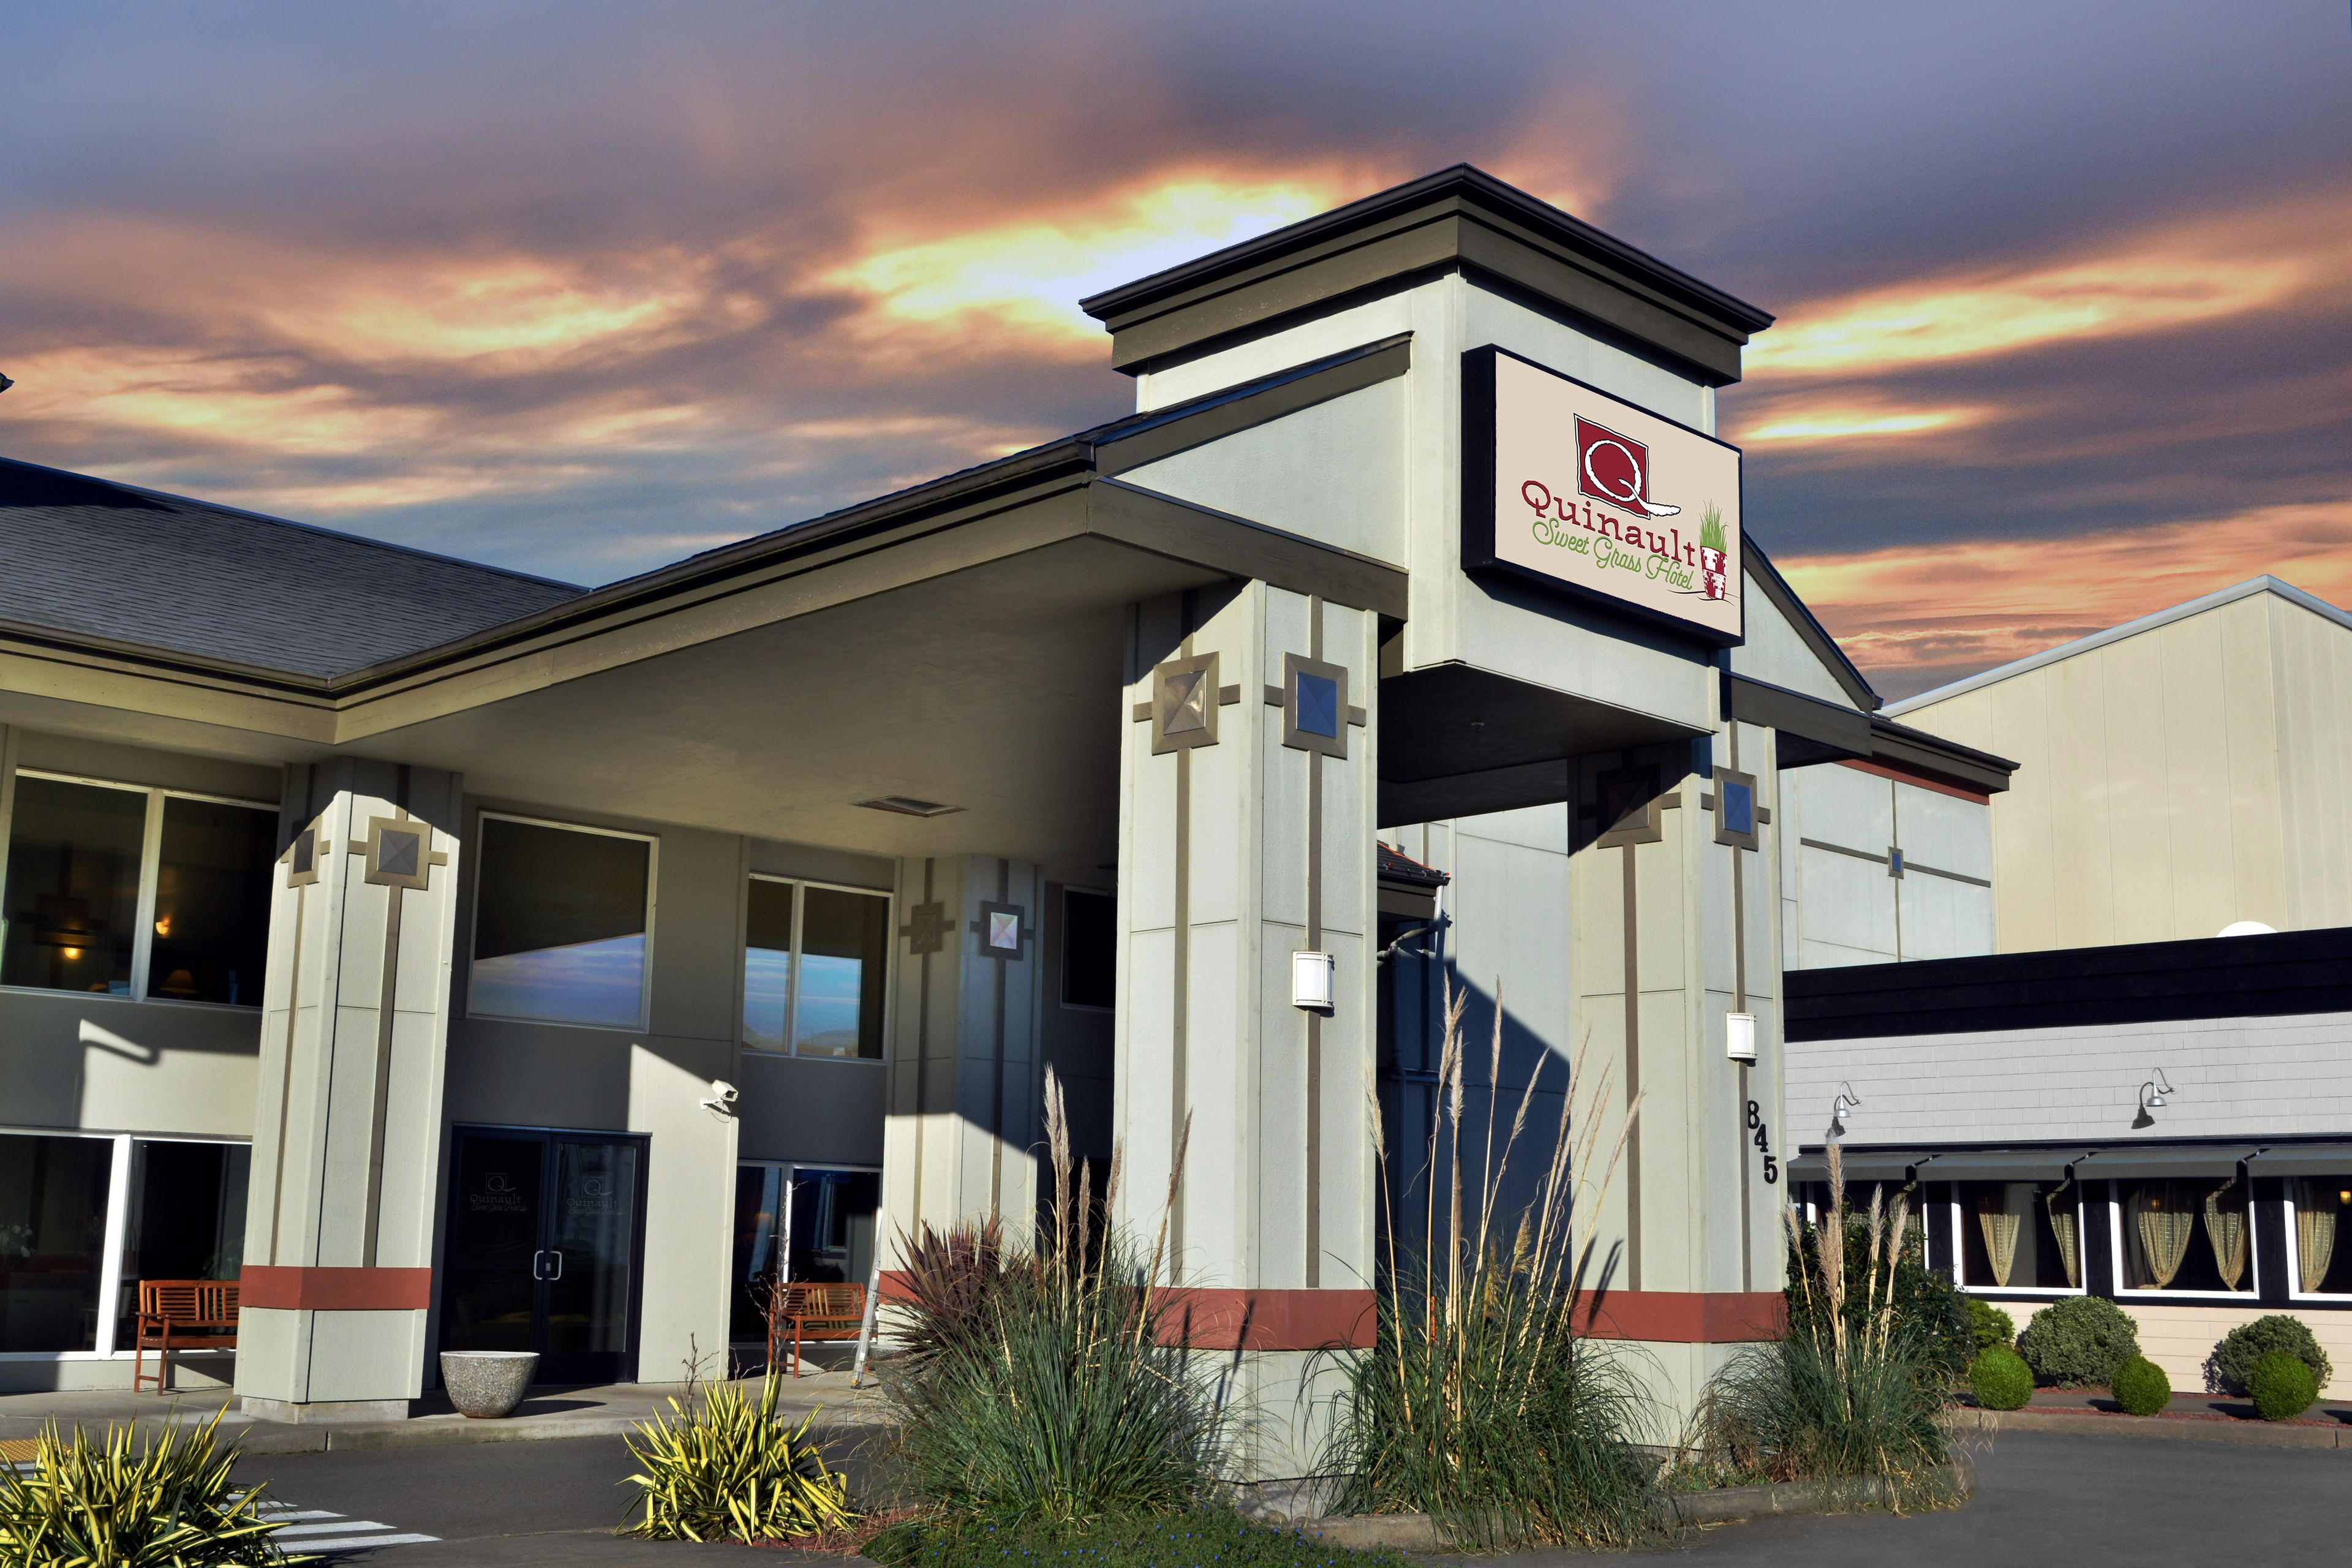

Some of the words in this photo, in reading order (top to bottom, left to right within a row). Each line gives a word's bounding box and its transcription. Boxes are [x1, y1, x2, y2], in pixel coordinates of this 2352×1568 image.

[1585, 439, 1681, 516] Q
[1521, 480, 1695, 567] Quinault
[1532, 517, 1589, 555] Sweet
[1593, 536, 1642, 573] Grass
[1645, 554, 1694, 590] Hotel
[1747, 1100, 1777, 1184] 845
[470, 1194, 521, 1204] Quinault
[488, 1175, 516, 1192] Q
[567, 1197, 617, 1207] Quinault
[584, 1179, 613, 1196] Q
